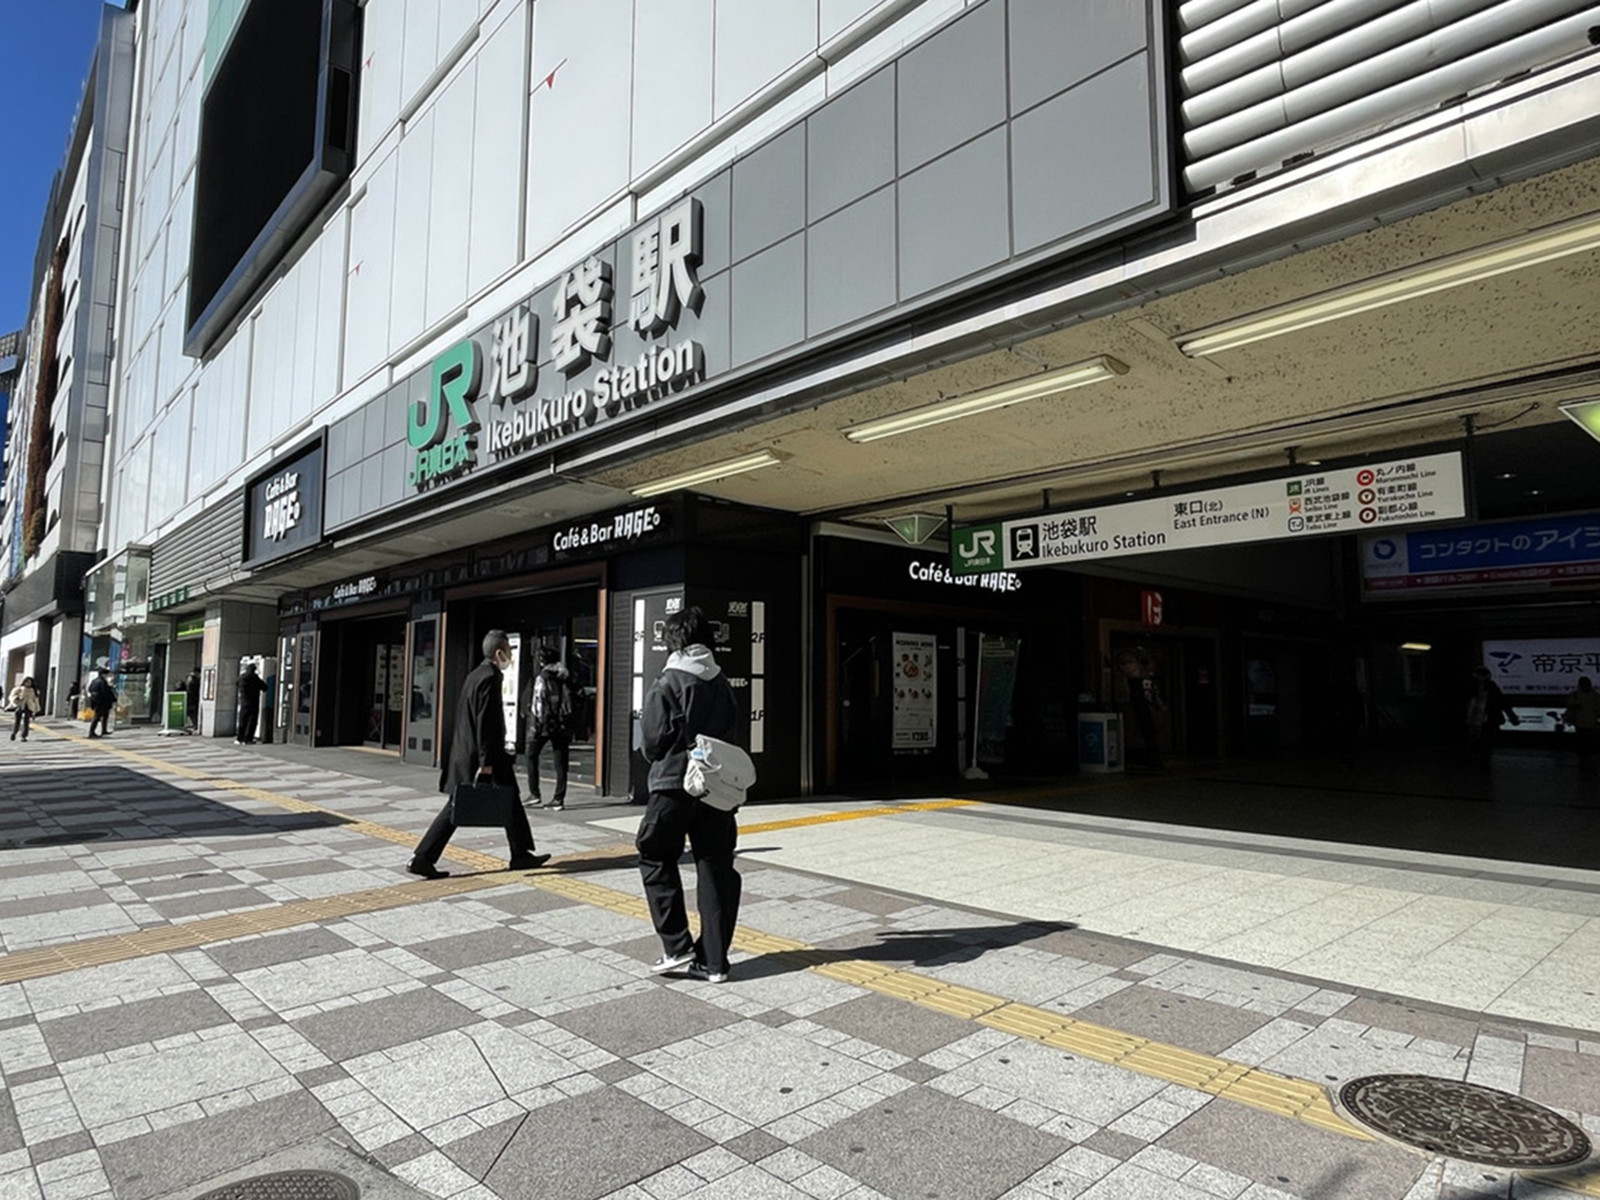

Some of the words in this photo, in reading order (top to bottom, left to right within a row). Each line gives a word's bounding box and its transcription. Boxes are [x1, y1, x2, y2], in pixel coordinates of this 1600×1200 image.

[487, 197, 700, 406] 池袋駅
[407, 339, 473, 448] JR
[487, 387, 587, 453] Ikebukuro
[593, 339, 695, 409] Station
[408, 430, 470, 486] JR東日本
[1375, 463, 1416, 478] 丸ノ内線
[1375, 473, 1418, 485] Marunouchi
[1419, 469, 1436, 478] Line
[1304, 477, 1325, 489] JR線
[1377, 482, 1418, 496] 有楽町線
[1304, 491, 1350, 506] 西武池袋線
[1417, 489, 1434, 499] Line
[1173, 500, 1223, 518] 東口(北)
[1322, 501, 1338, 511] Line
[1378, 501, 1418, 516] 副都心線
[1420, 509, 1436, 518] Line
[614, 507, 656, 539] RAGE
[1173, 518, 1199, 530] East
[1200, 510, 1250, 527] Entrance
[1251, 507, 1270, 520] (N)
[1305, 510, 1351, 525] 東武東上線
[1322, 520, 1338, 529] Line
[1042, 515, 1097, 541] 池袋駅
[959, 530, 995, 558] JR
[1042, 539, 1108, 559] Ikebukuro
[1113, 531, 1166, 549] Station
